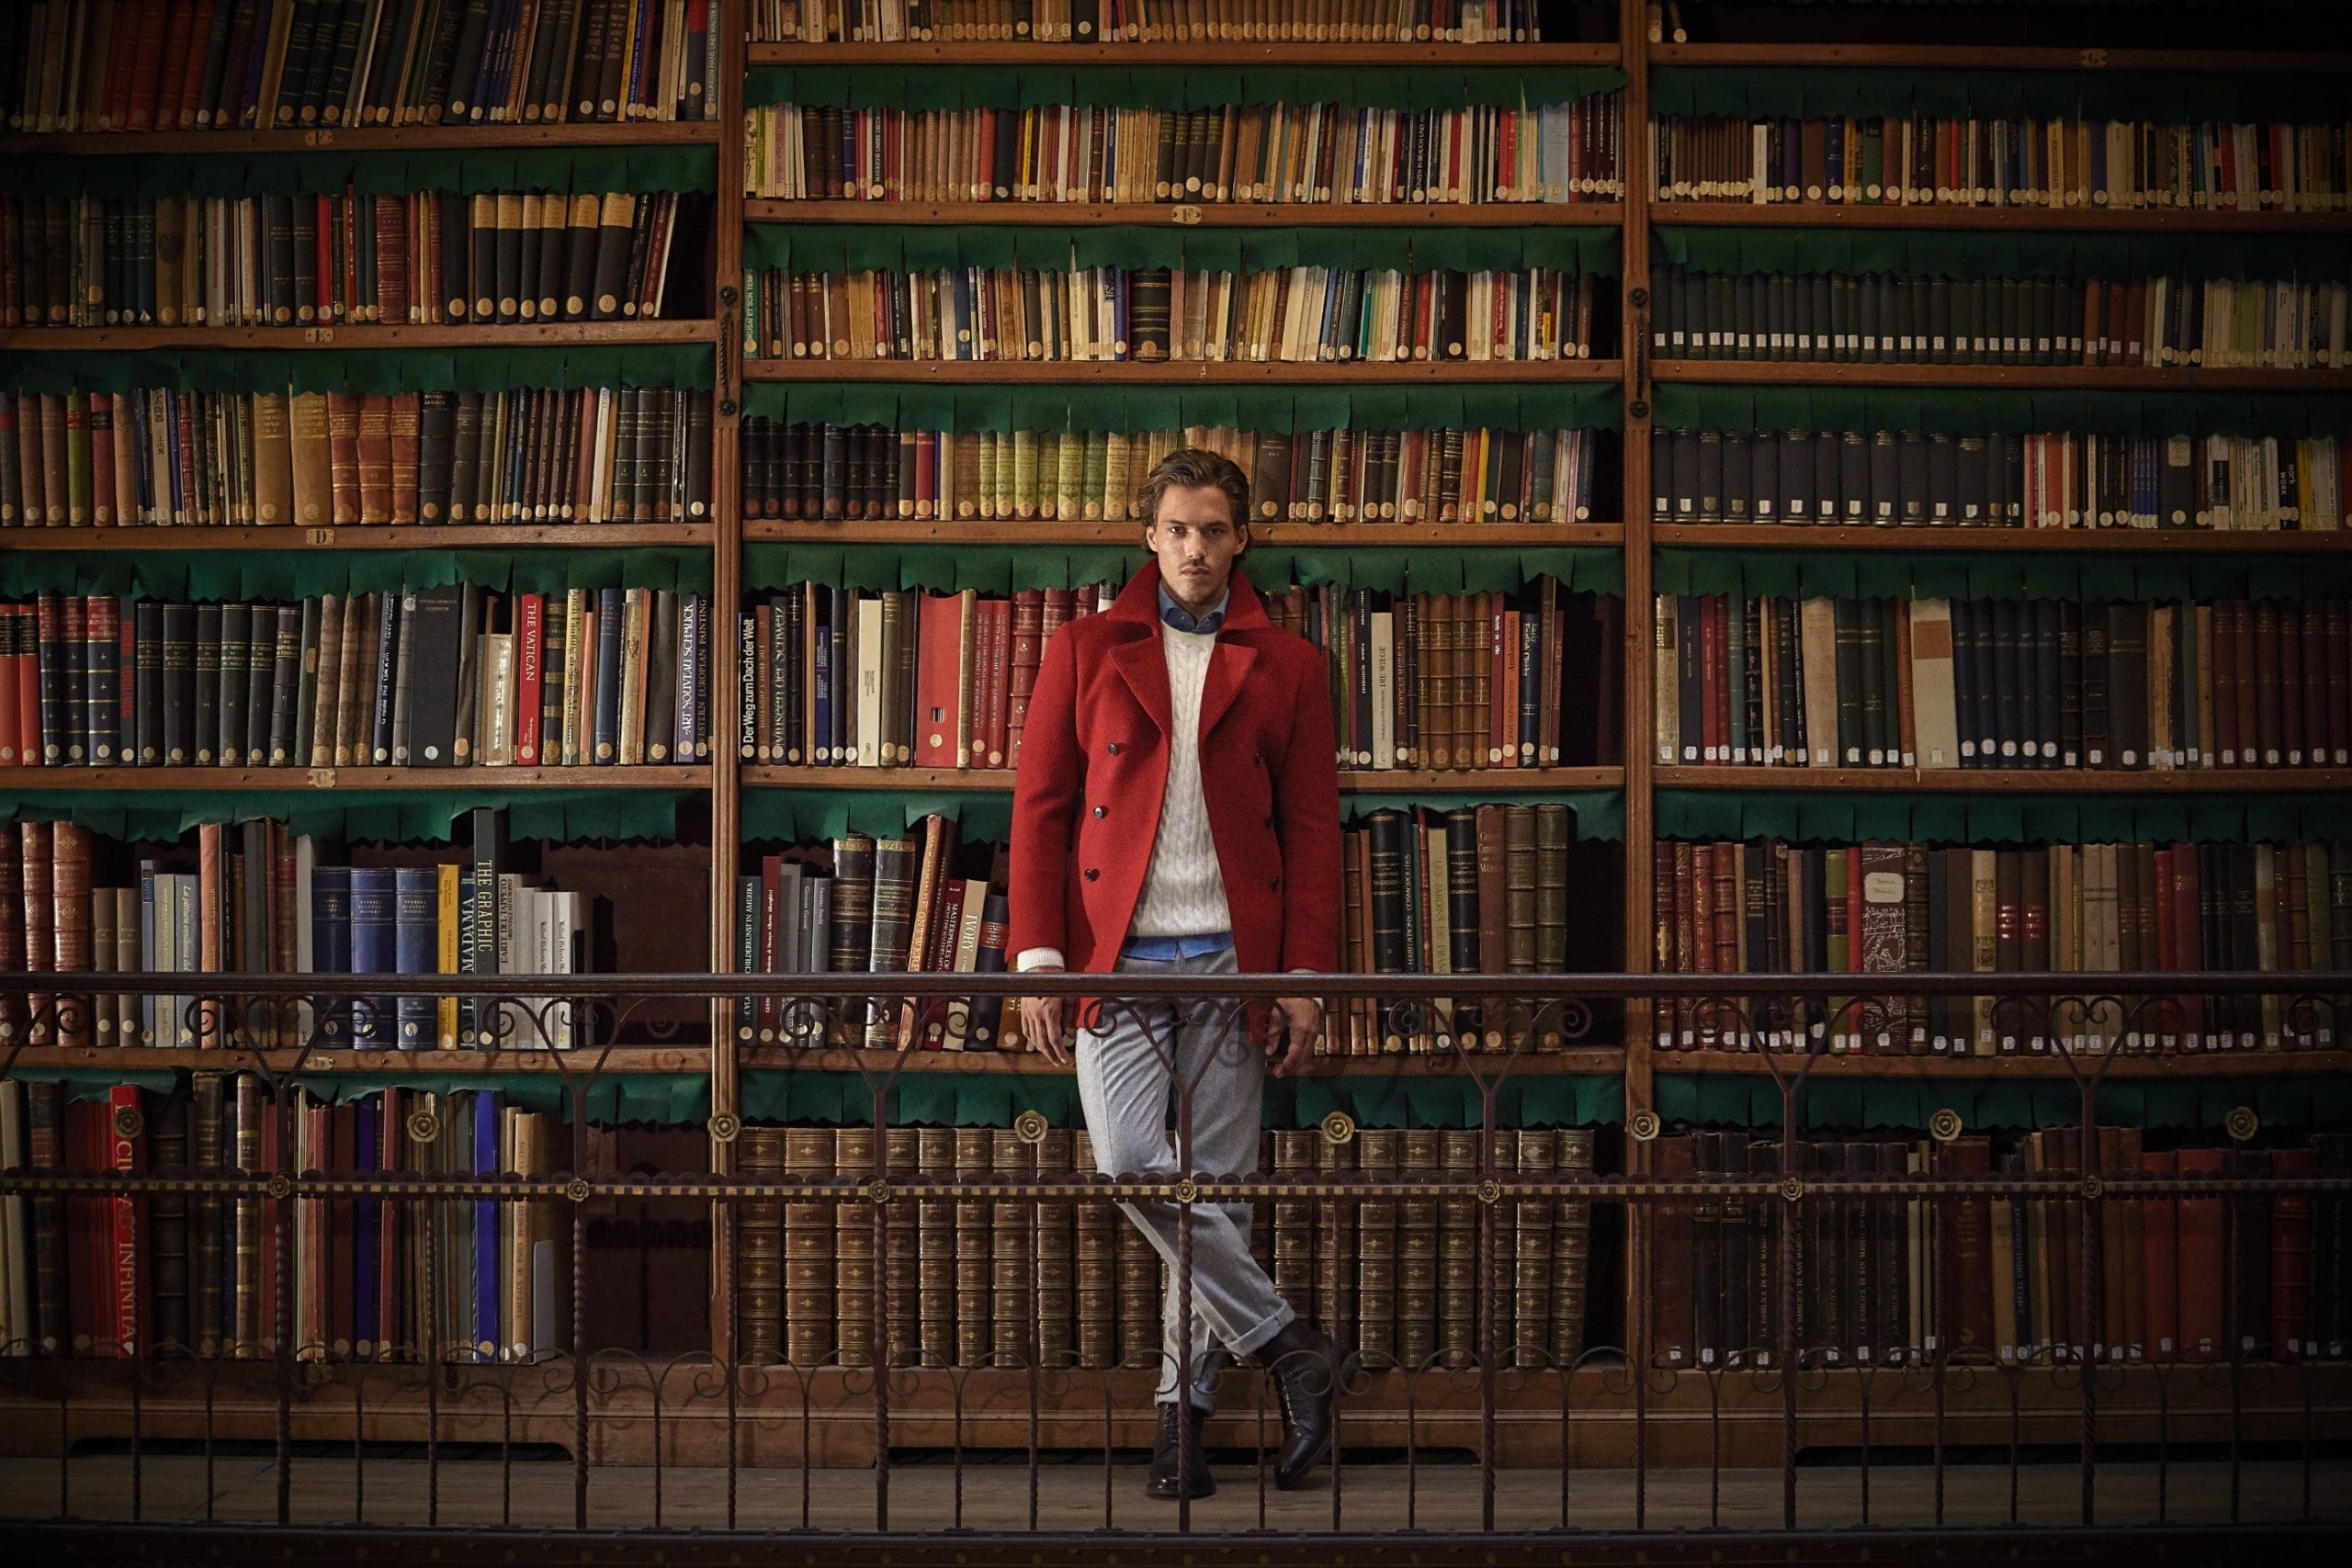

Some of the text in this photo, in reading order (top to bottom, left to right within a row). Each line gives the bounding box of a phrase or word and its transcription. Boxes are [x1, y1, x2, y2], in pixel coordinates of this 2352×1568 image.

[316, 529, 327, 544] D
[526, 603, 537, 681] THE VATICAN
[699, 599, 707, 645] PAINTING
[774, 606, 786, 661] Schweiz
[682, 604, 694, 735] ART NOUVEAU SCHMUCK
[743, 619, 755, 742] Der Weg zum Dach der Welt
[772, 665, 786, 687] der
[182, 897, 191, 924] pittura
[184, 886, 191, 897] La
[478, 860, 492, 952] THE GRAPHIC
[1433, 860, 1447, 973] LES JARDINS DE FRAN
[462, 897, 474, 973] MADAMA
[911, 911, 926, 972] ONTWERP
[944, 904, 959, 970] MASTERPIECES OF
[961, 915, 978, 952] IVORY
[461, 997, 474, 1029] VIL
[118, 1242, 134, 1339] INFINITA
